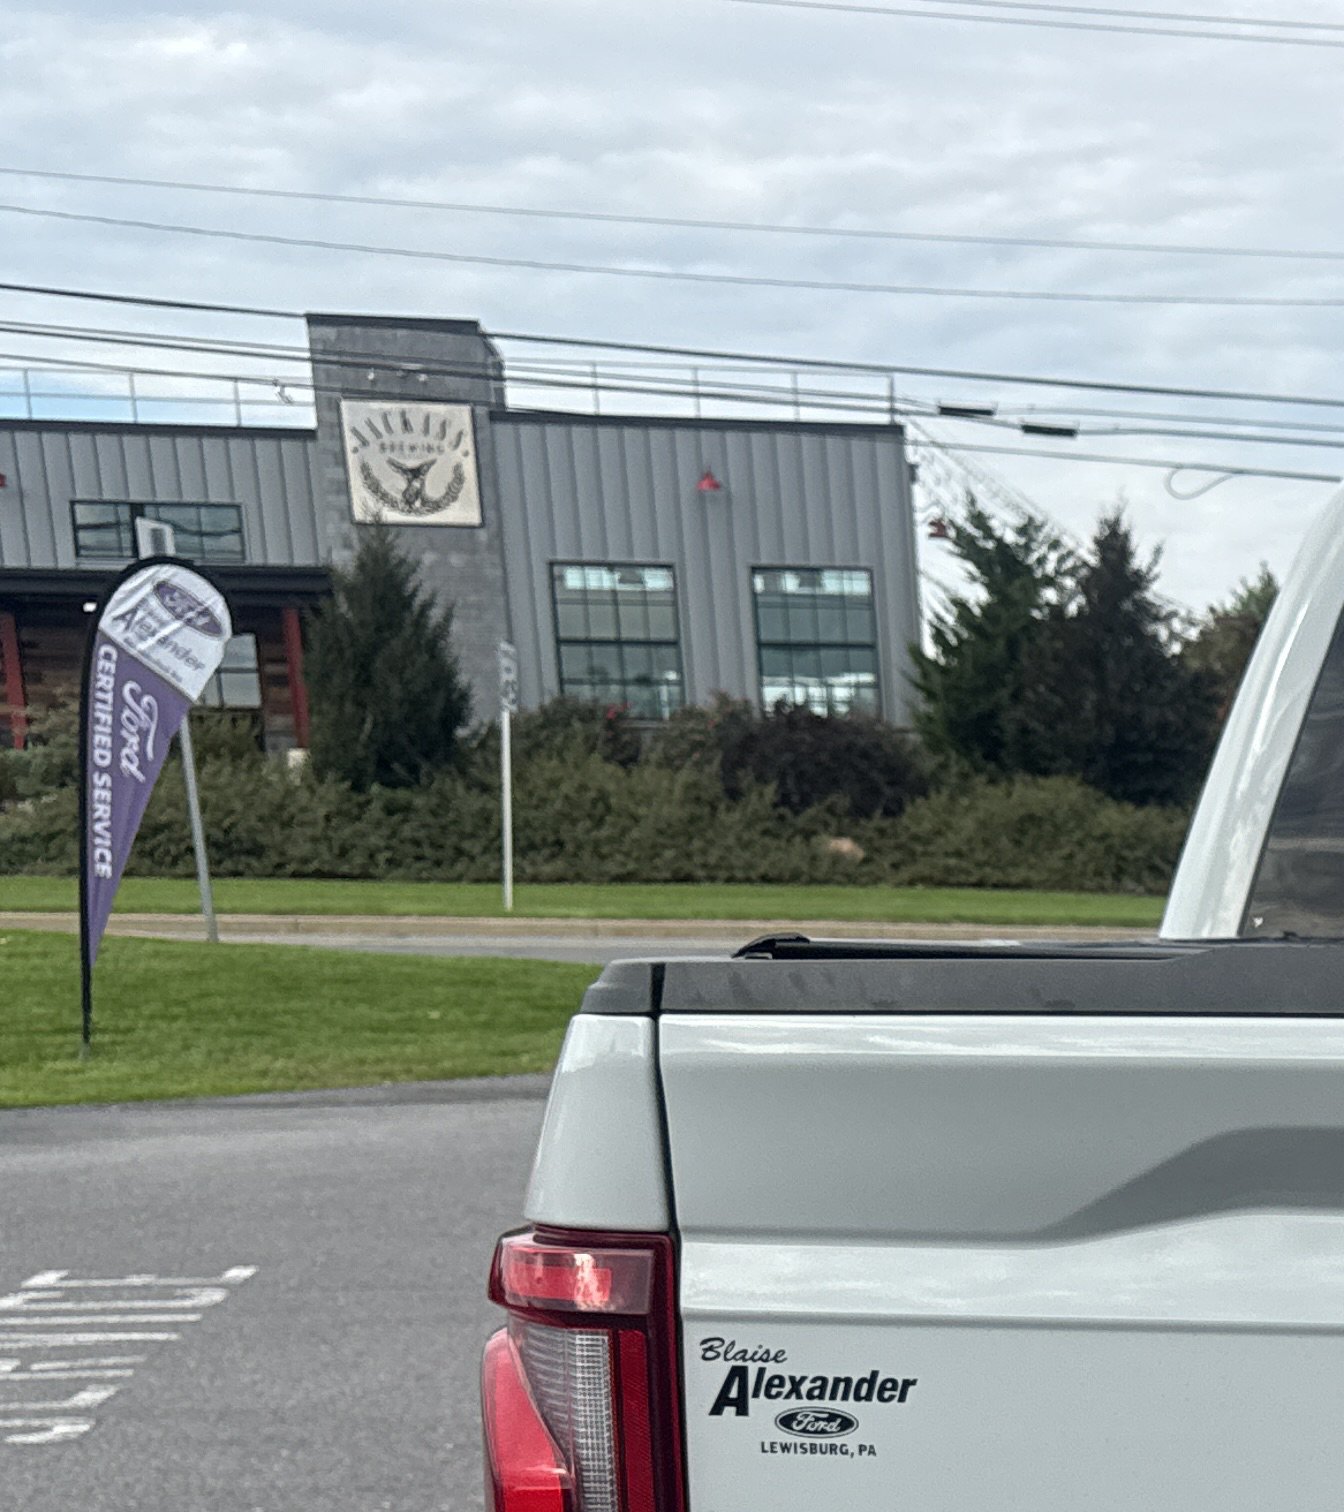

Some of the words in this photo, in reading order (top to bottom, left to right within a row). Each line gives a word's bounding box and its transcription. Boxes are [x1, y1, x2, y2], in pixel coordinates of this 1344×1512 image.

[94, 643, 118, 767] CERTIFIED
[120, 680, 158, 784] Ford
[93, 772, 112, 880] SERVICE
[699, 1336, 788, 1364] Blaise
[708, 1365, 918, 1417] Alexander
[791, 1411, 842, 1432] Ford
[760, 1441, 855, 1458] LEWISBURG,
[858, 1443, 877, 1457] PA
